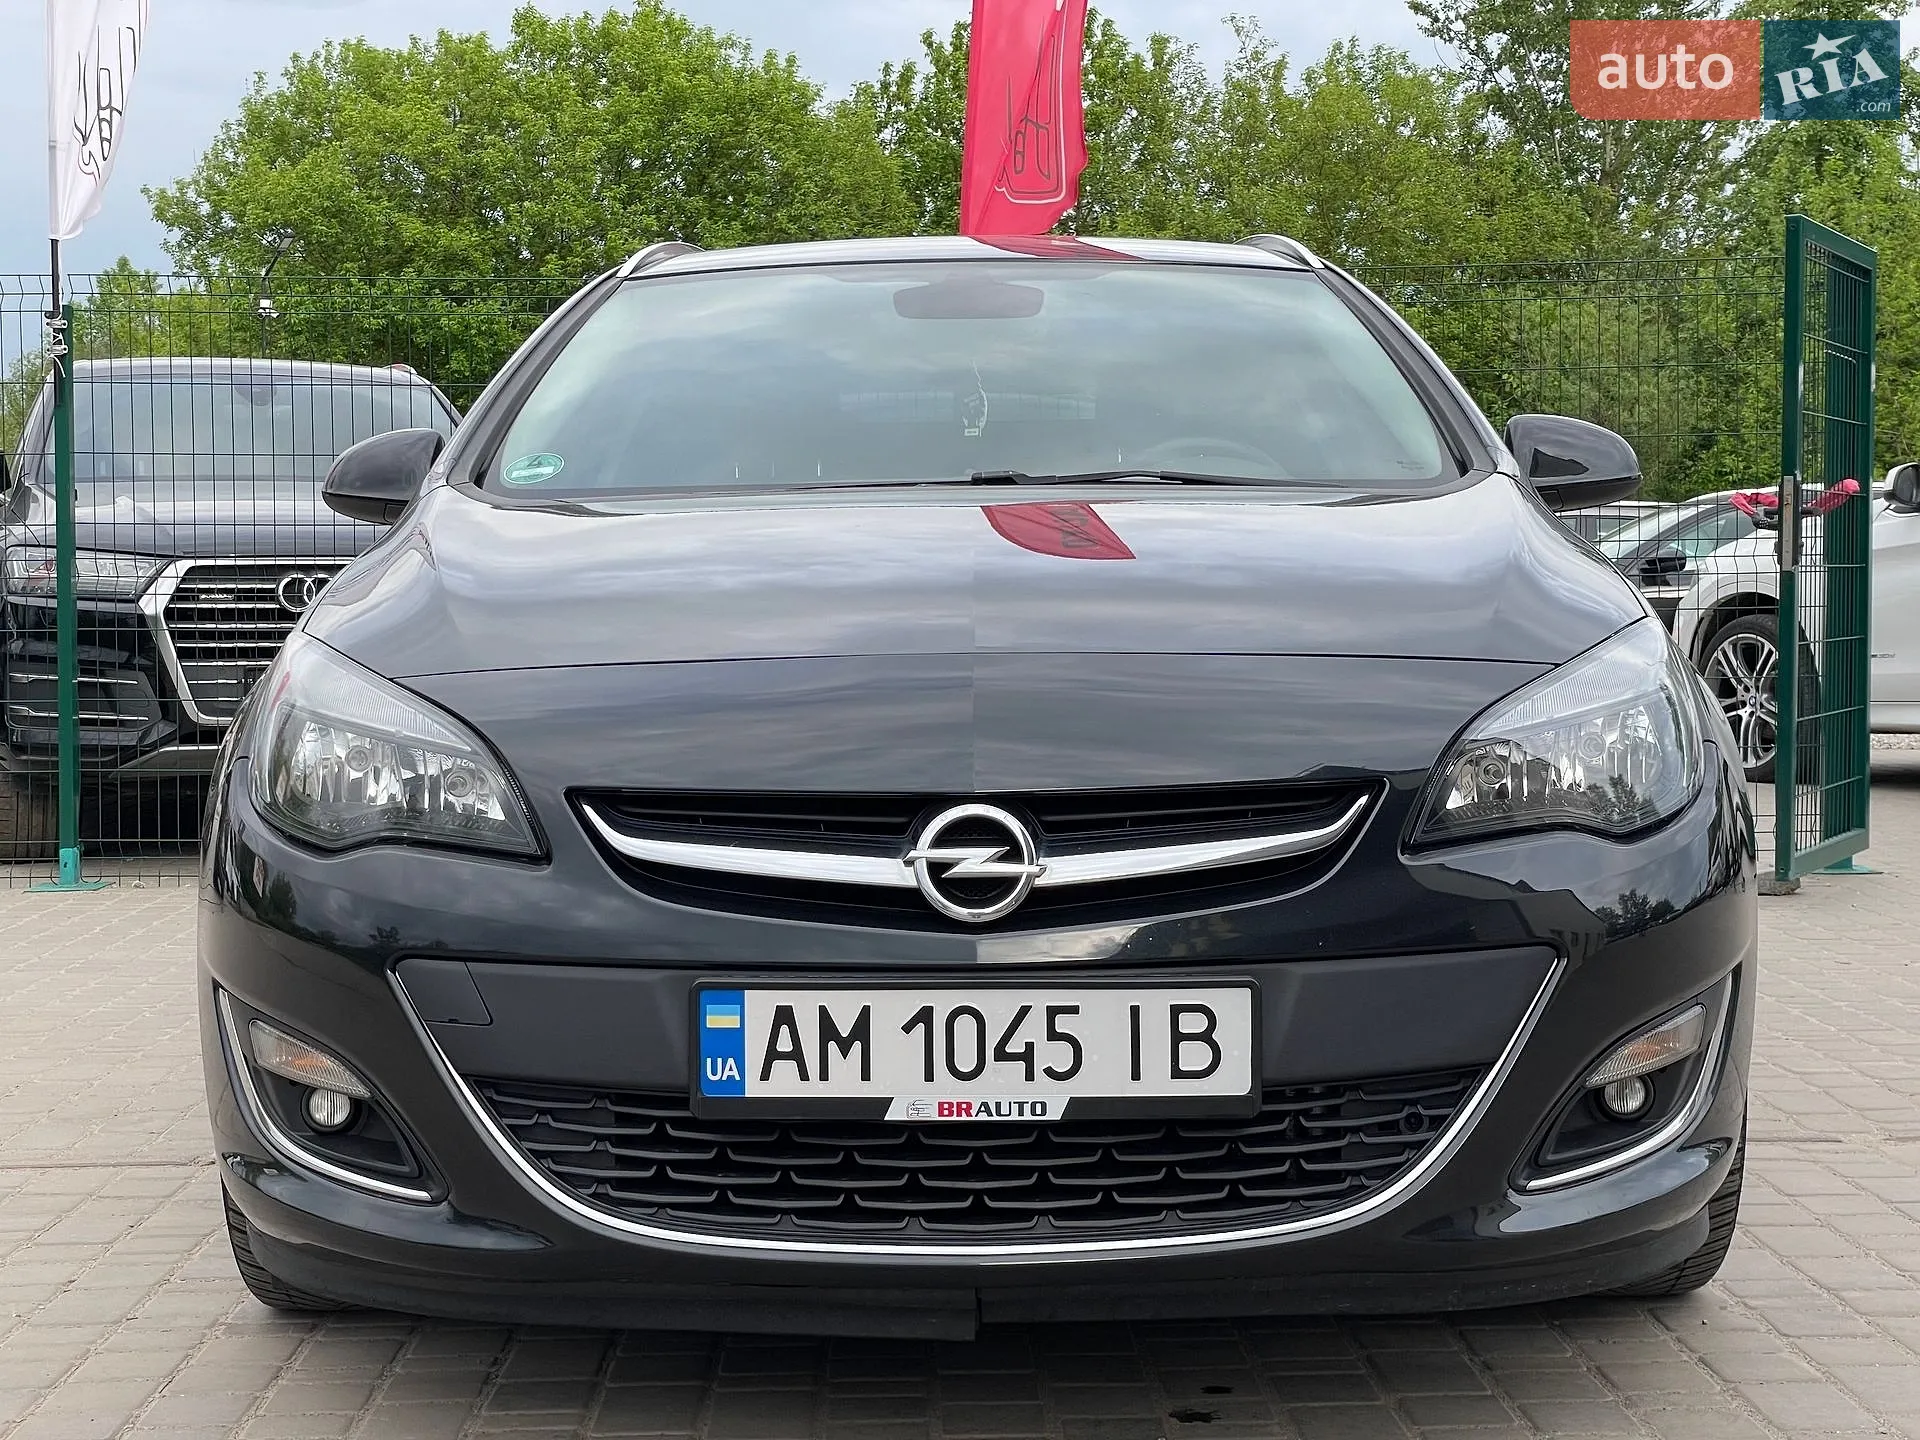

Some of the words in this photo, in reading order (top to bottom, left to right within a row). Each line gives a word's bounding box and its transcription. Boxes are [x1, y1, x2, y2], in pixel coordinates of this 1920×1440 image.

[758, 1003, 872, 1083] AM
[900, 1003, 1083, 1083] 1045
[1129, 1003, 1223, 1083] IB
[706, 1057, 740, 1081] UA
[937, 1100, 1048, 1118] BRAUTO
